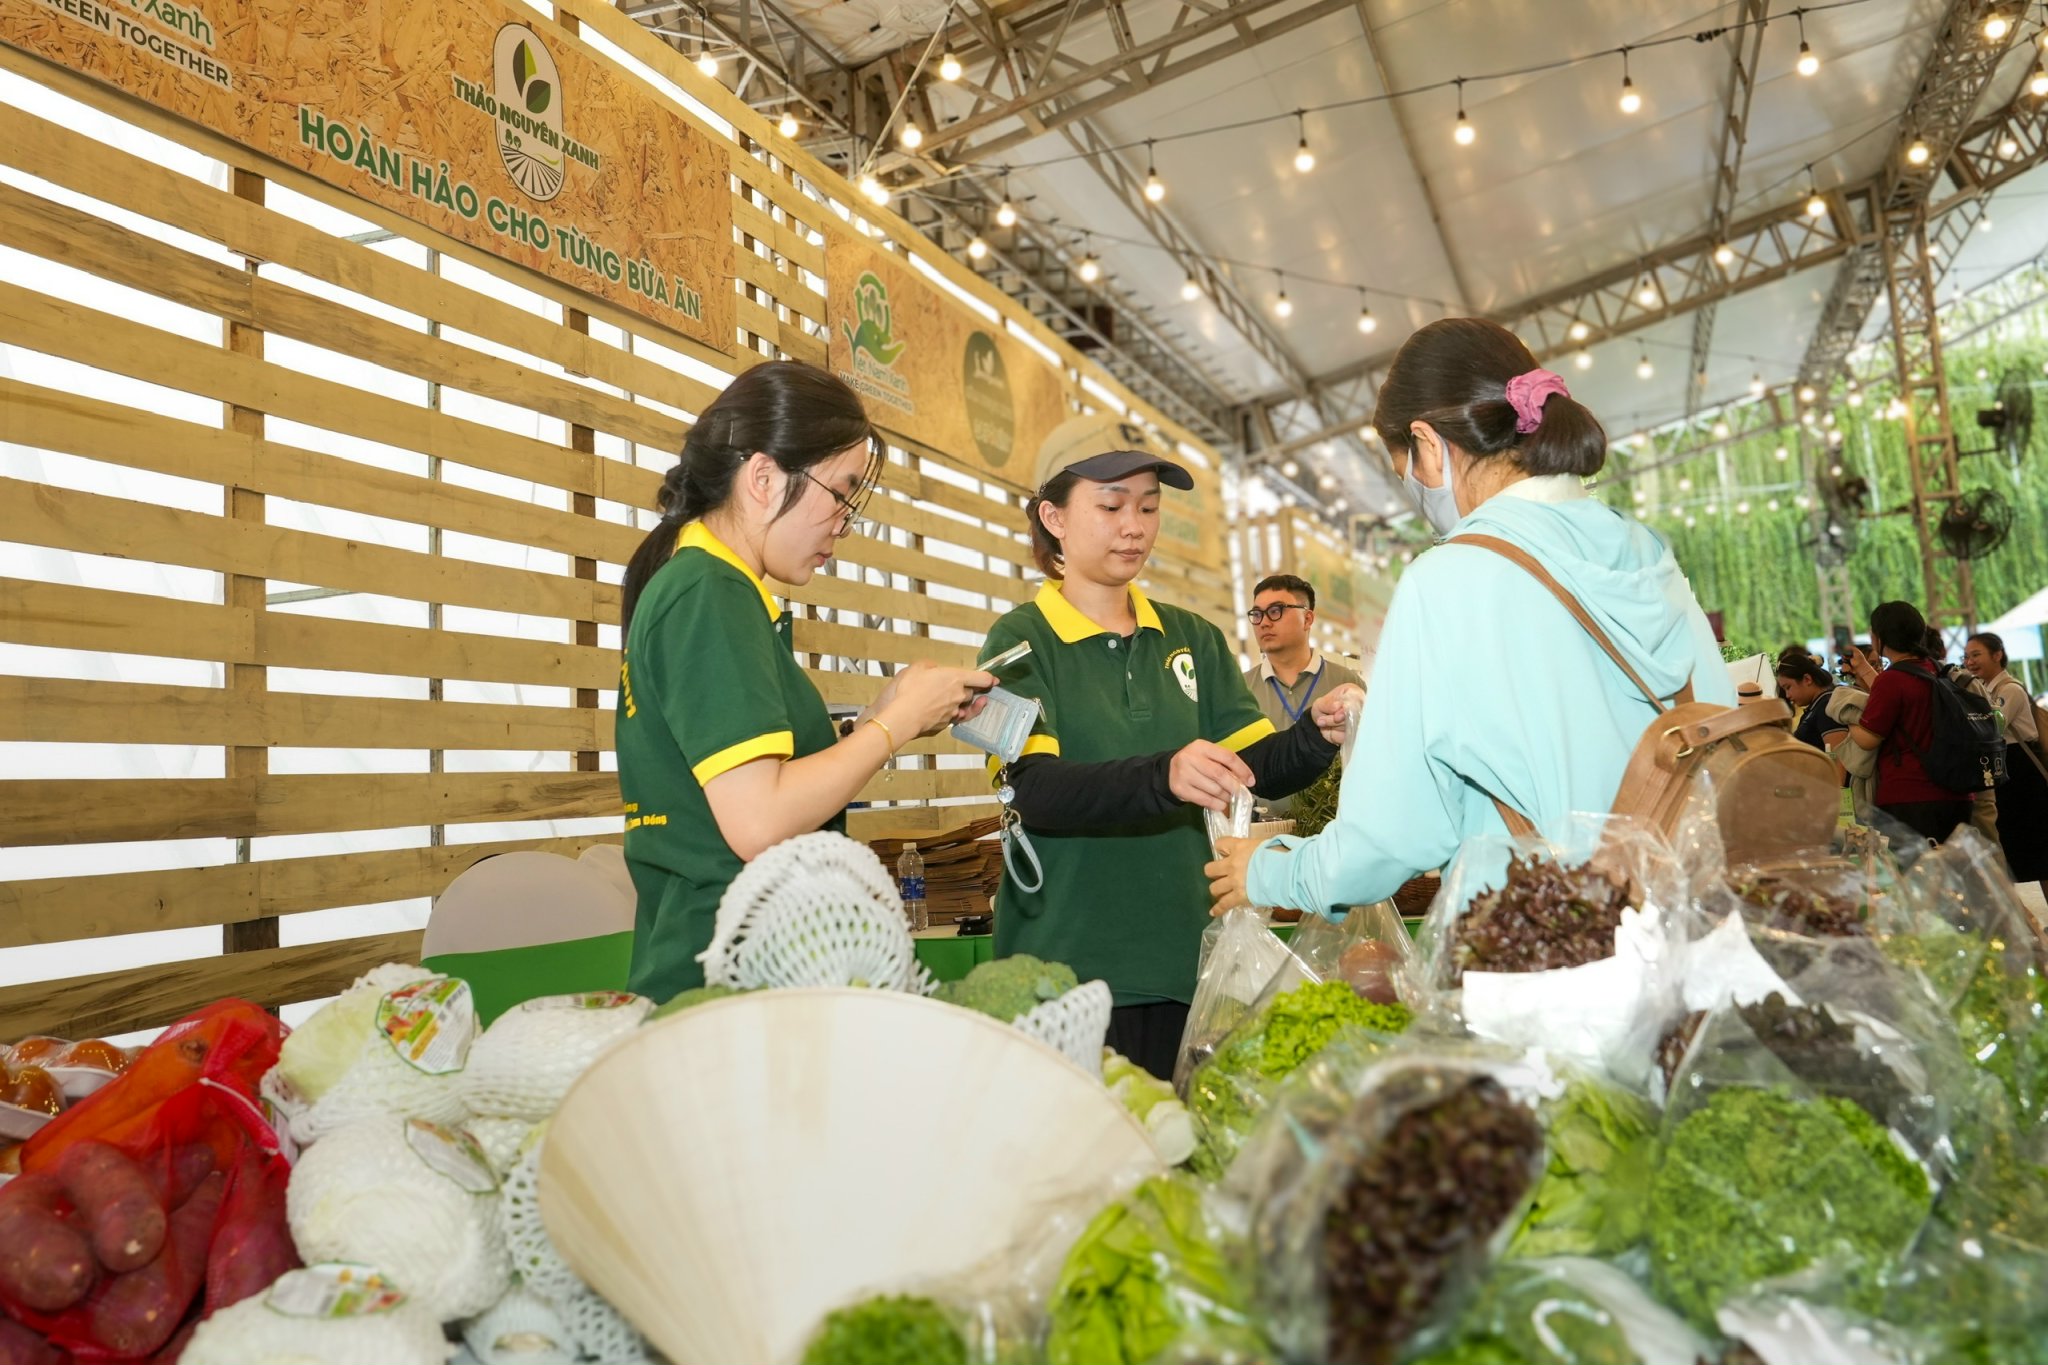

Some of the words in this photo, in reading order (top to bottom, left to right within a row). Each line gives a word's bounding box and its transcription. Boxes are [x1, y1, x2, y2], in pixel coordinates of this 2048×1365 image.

[116, 18, 229, 86] TOGETHER
[453, 76, 497, 116] THẢO
[500, 102, 559, 149] NGUYÊN
[561, 135, 599, 171] XANH
[301, 107, 401, 187] HOÀN
[412, 161, 478, 218] HẢO
[487, 199, 550, 249] CHO
[556, 226, 621, 281] TỪNG
[627, 259, 669, 305] BỮA
[673, 278, 700, 320] ĂN
